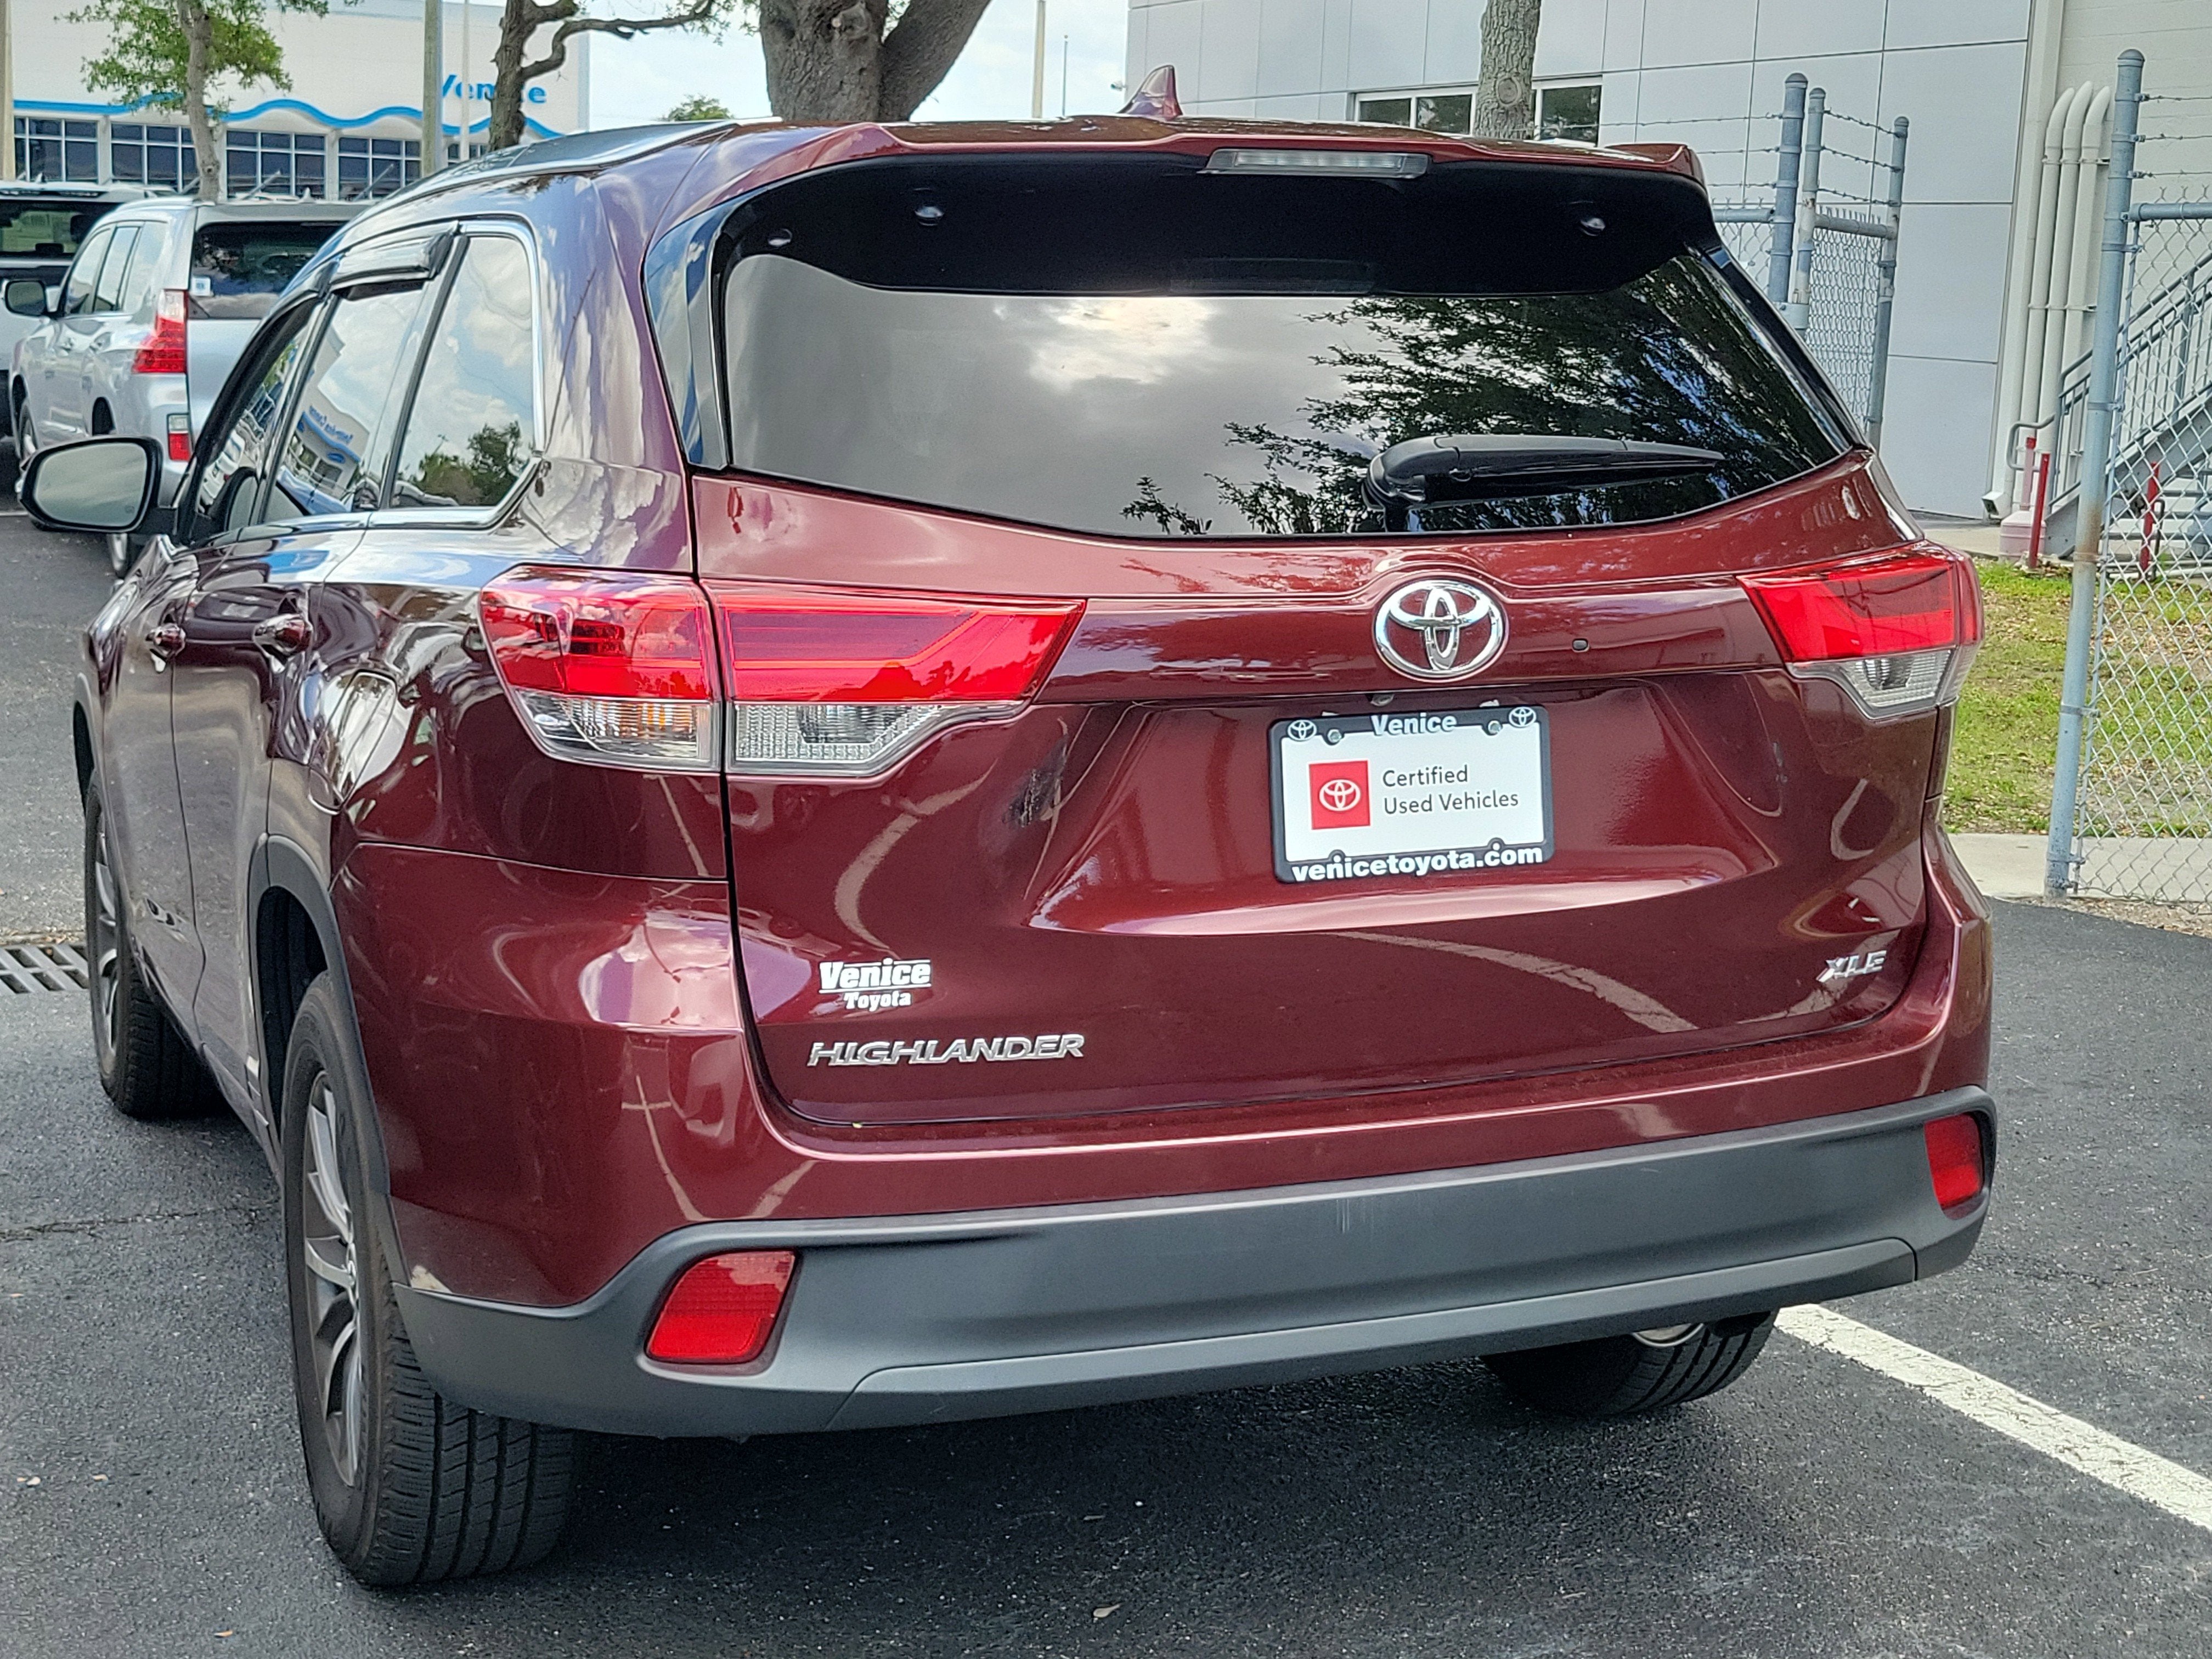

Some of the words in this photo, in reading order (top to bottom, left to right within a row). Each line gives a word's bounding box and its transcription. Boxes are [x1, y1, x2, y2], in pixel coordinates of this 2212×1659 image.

[442, 74, 546, 104] Vene
[1371, 713, 1458, 736] Venice
[1383, 764, 1468, 787] Certified
[1384, 795, 1432, 814] Used
[1438, 789, 1519, 811] Vehicles
[1292, 847, 1543, 882] venicetoyota.com
[820, 958, 932, 990] Venice
[1816, 950, 1887, 983] XLE
[844, 990, 912, 1012] Toyota
[807, 1034, 1085, 1066] HIGHLANDER
